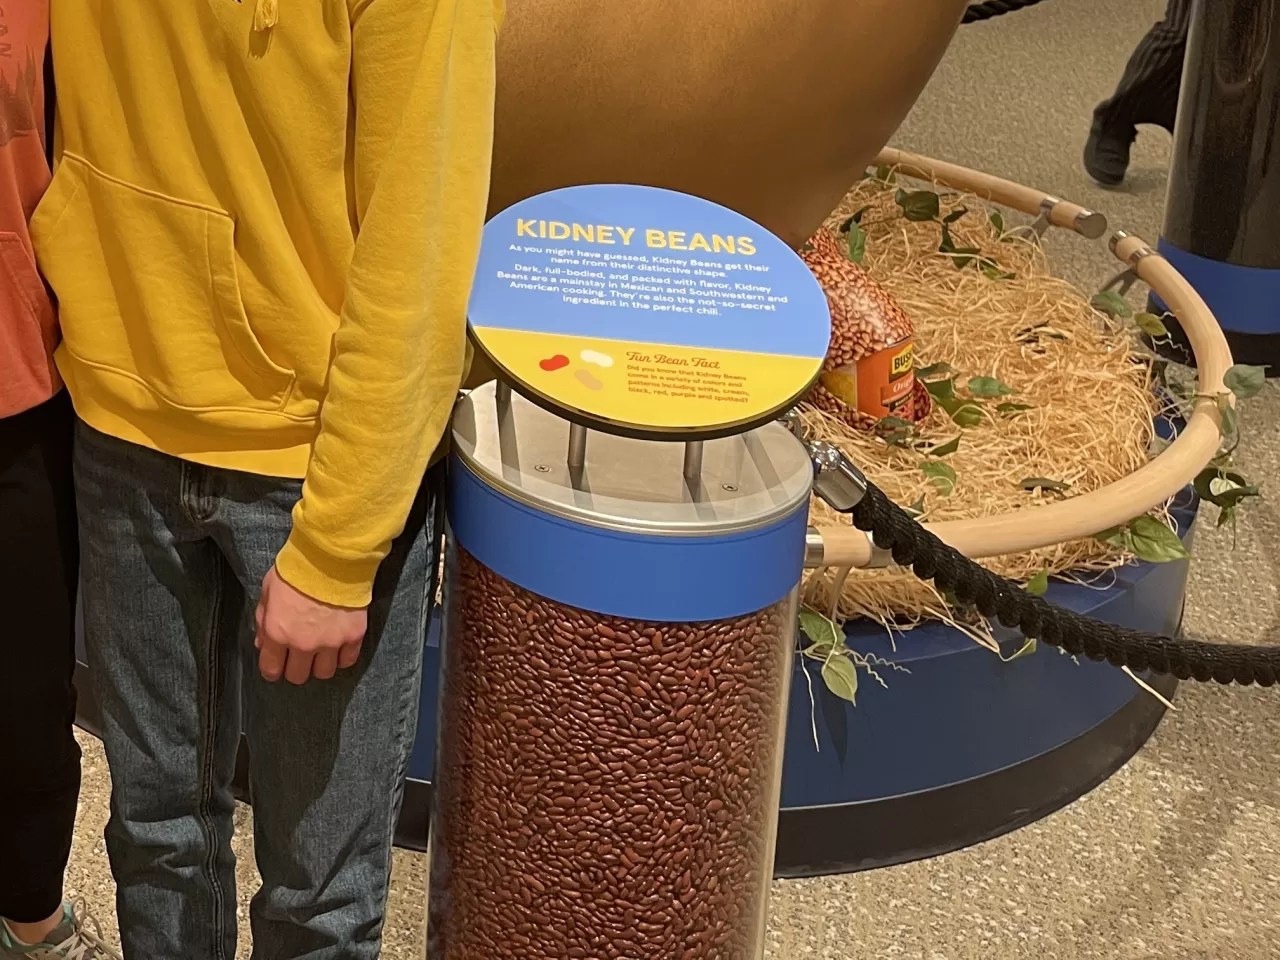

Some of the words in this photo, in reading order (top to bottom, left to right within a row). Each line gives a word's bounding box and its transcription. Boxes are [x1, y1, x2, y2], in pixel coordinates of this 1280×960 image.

[516, 218, 636, 246] KIDNEY
[645, 228, 757, 256] BEANS
[509, 243, 521, 252] As
[524, 246, 542, 254] you
[545, 247, 574, 257] might
[577, 250, 601, 259] have
[604, 253, 649, 263] guessed,
[652, 256, 687, 267] Kidney
[690, 260, 722, 269] Beans
[725, 263, 741, 272] get
[744, 263, 769, 272] their
[550, 257, 579, 265] name
[582, 258, 607, 268] from
[610, 261, 634, 270] their
[638, 264, 691, 275] distinctive
[694, 269, 728, 279] shape.
[497, 270, 528, 280] Beans
[559, 277, 605, 288] mainstay
[608, 281, 618, 289] in
[620, 282, 663, 293] Mexican
[666, 287, 686, 295] and
[689, 286, 765, 301] Southwestern
[767, 295, 788, 304] and
[608, 272, 629, 281] and
[631, 275, 670, 285] packed
[673, 278, 696, 287] with
[734, 283, 771, 294] Kidney
[509, 281, 559, 293] American
[562, 286, 607, 298] cooking.
[609, 290, 651, 300] They're
[653, 294, 674, 303] also
[677, 296, 695, 305] the
[698, 298, 777, 312] not-so-secret
[562, 295, 616, 307] ingredient
[619, 300, 629, 308] in
[632, 301, 650, 310] the
[652, 304, 694, 314] perfect
[696, 306, 722, 316] chili.
[626, 351, 651, 363] Fun
[654, 353, 689, 366] Bean
[691, 357, 720, 369] Fact
[894, 352, 912, 370] BUS
[628, 380, 660, 388] patterns
[662, 382, 696, 391] including
[666, 376, 691, 384] variety
[696, 371, 722, 379] Kidney
[723, 373, 747, 381] Beans
